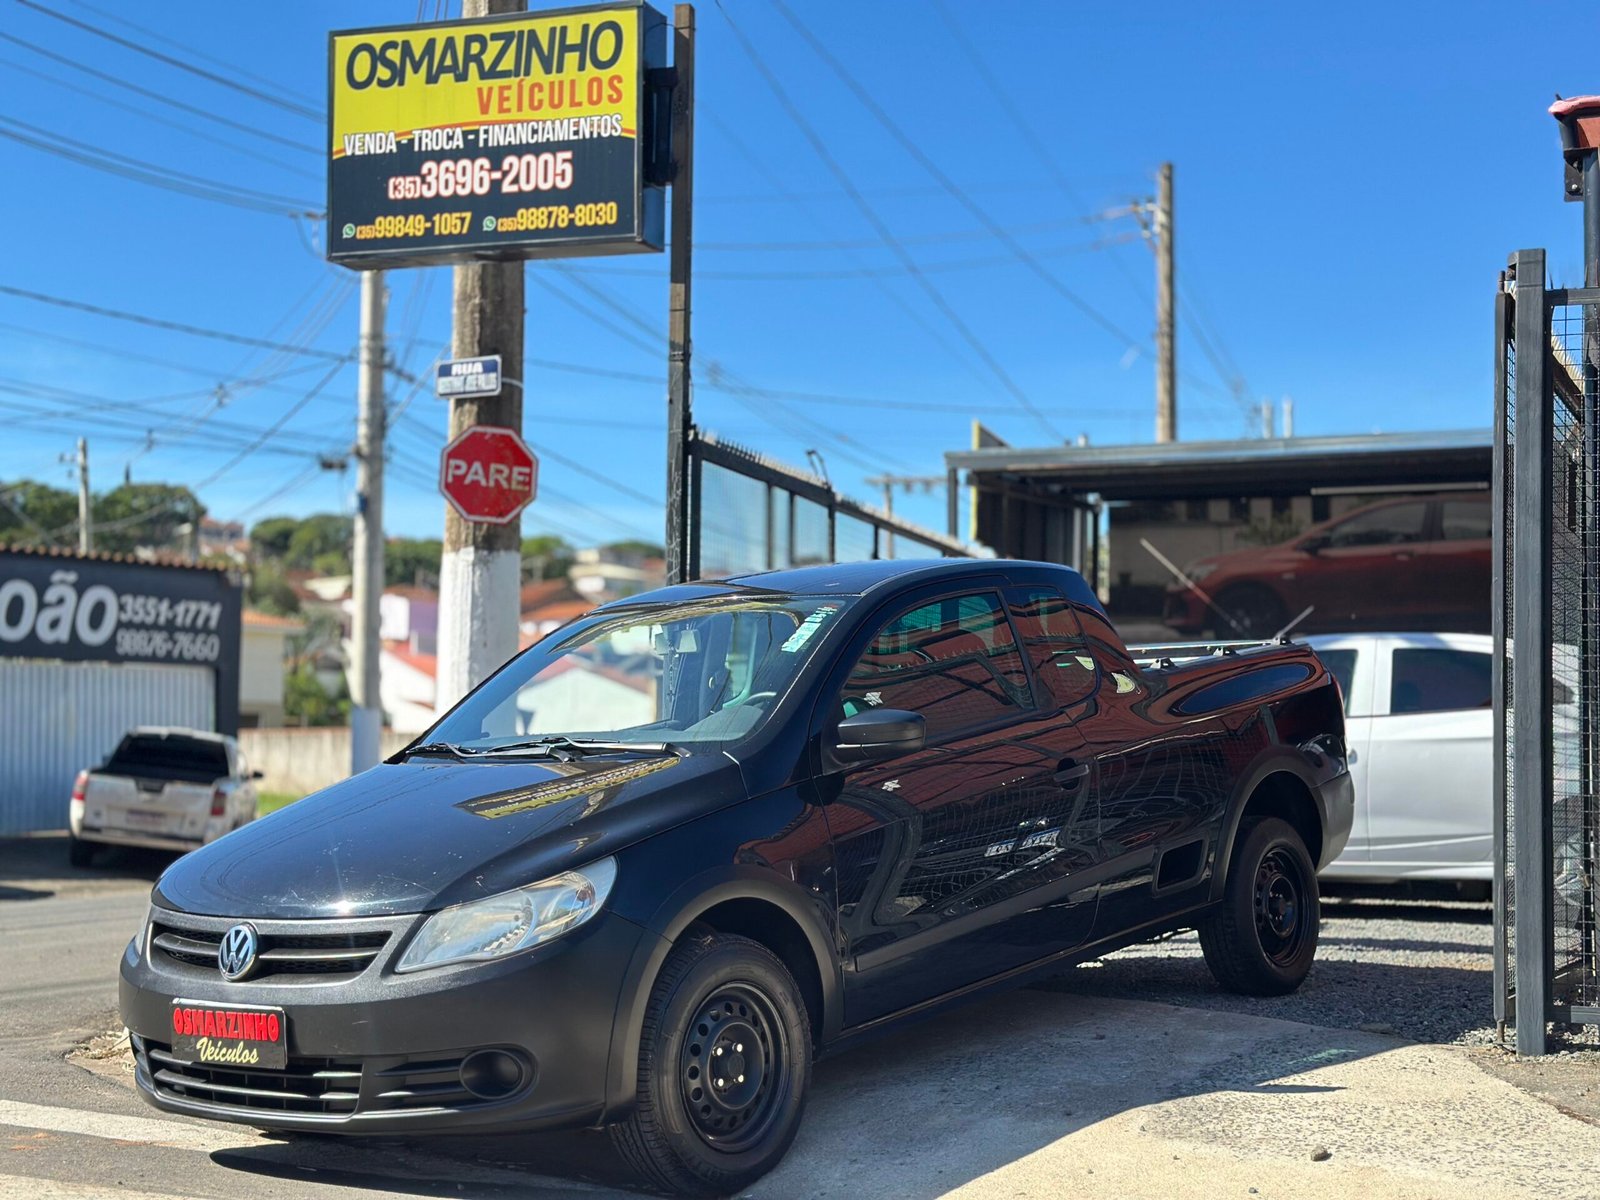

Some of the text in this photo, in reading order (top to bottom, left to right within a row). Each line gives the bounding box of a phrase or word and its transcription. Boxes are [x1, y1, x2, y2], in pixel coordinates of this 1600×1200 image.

[346, 20, 624, 89] OSMARZINHO
[477, 74, 624, 115] VEÍCULOS
[344, 131, 397, 156] VENDA
[412, 127, 463, 152] TROCA
[479, 114, 622, 148] FINANCIAMENTOS
[451, 361, 484, 376] RUA
[447, 459, 531, 491] PARE
[119, 594, 222, 630] 3551-1771
[173, 1007, 279, 1041] OSMARZINHO
